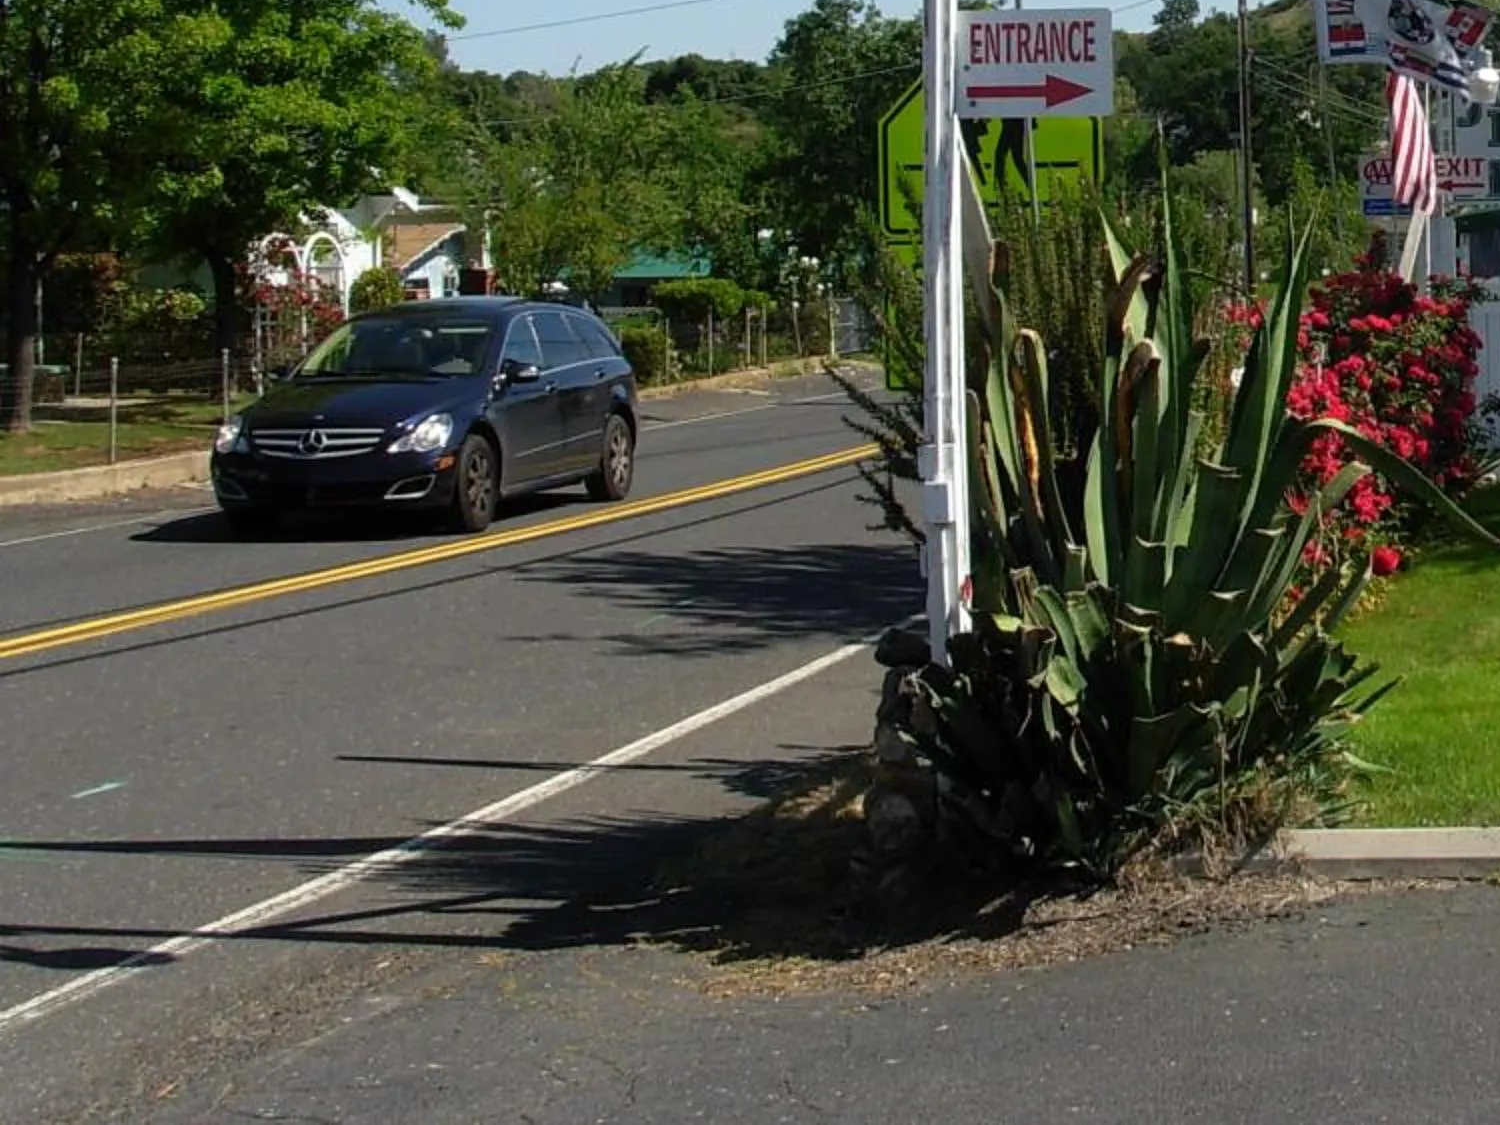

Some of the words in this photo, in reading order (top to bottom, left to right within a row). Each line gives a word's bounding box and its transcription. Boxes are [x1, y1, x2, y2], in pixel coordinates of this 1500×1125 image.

[969, 21, 1097, 64] ENTRANCE
[1364, 157, 1396, 185] AA
[1435, 158, 1484, 177] EXIT
